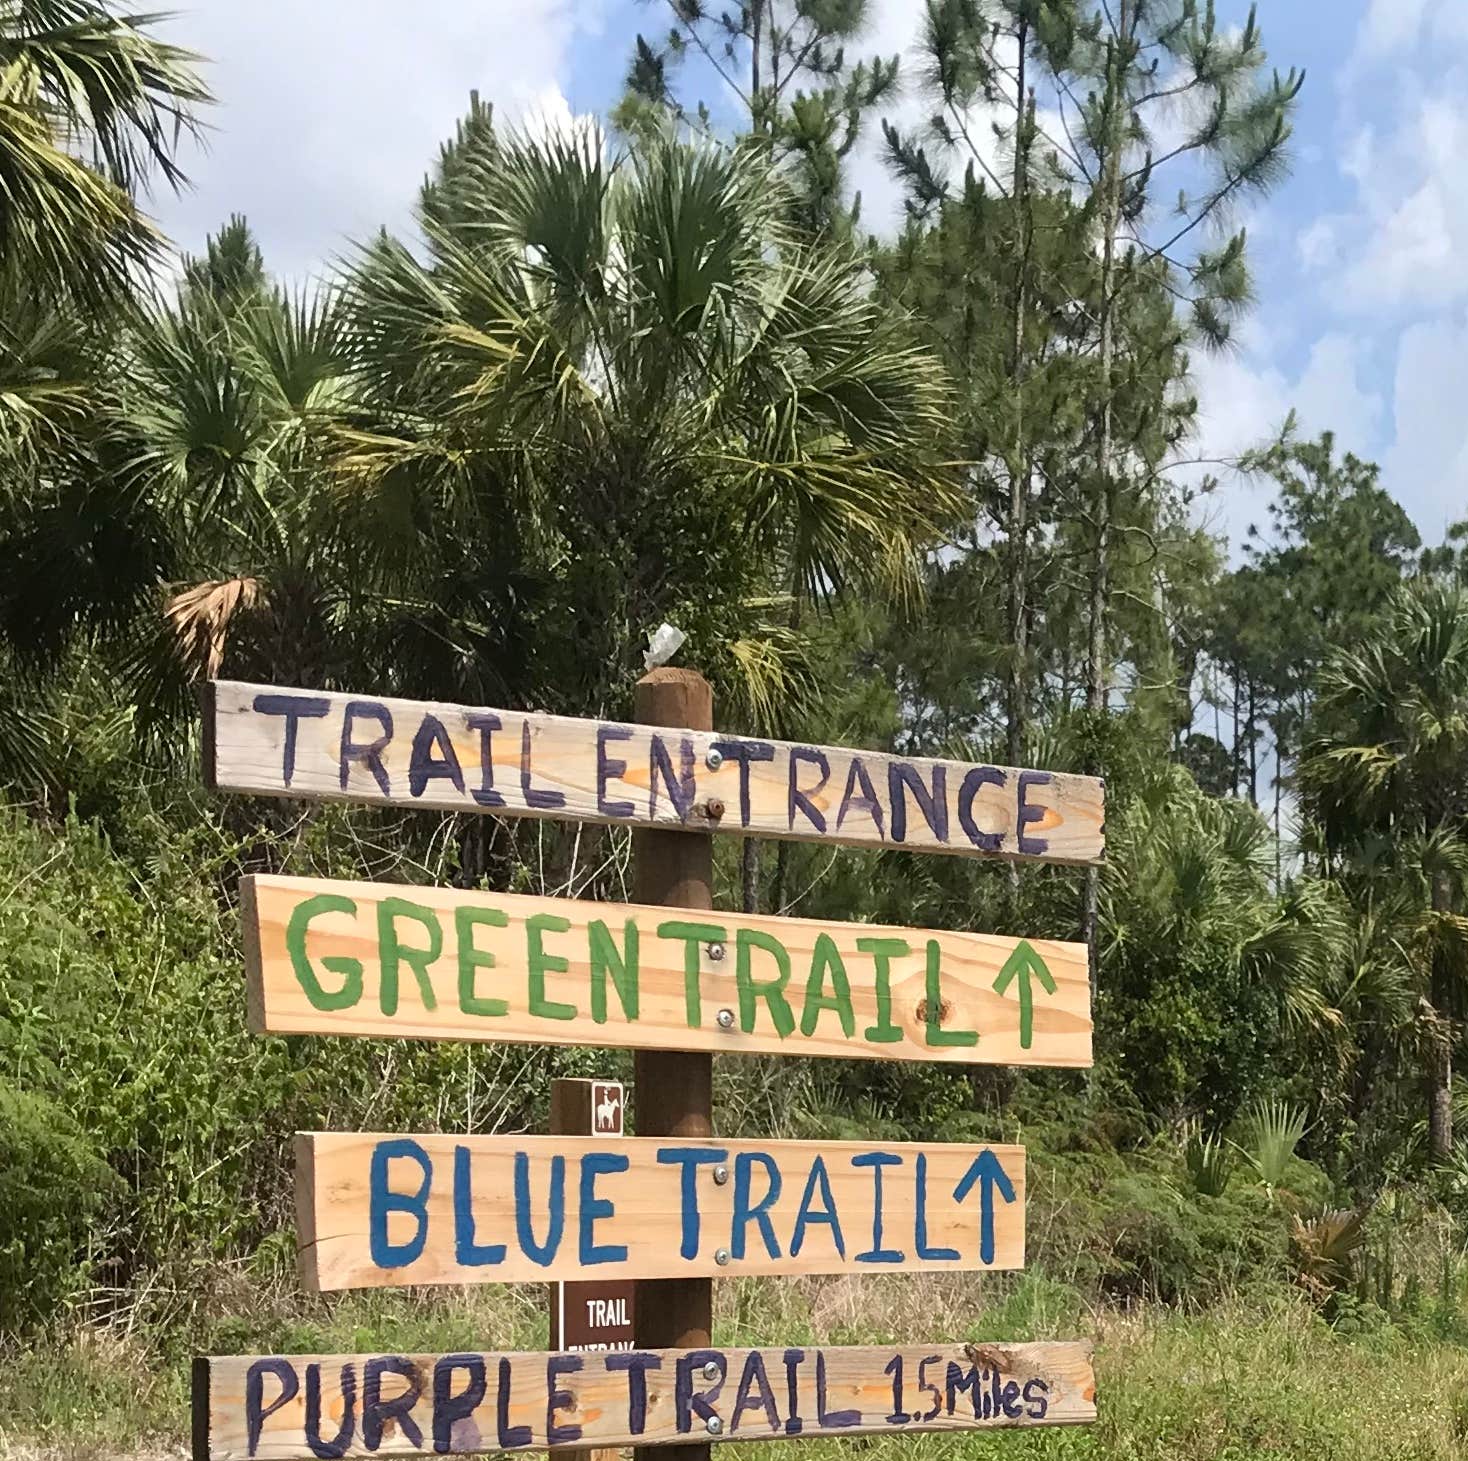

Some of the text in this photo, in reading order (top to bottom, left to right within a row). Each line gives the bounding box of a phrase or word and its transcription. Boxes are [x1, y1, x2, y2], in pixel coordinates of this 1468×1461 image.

[253, 694, 1057, 855] TRAIL ENTRANCE
[286, 893, 980, 1047] GREEN TRAIL
[369, 1138, 962, 1268] BLUE TRAIL
[586, 1298, 631, 1328] TRAIL
[246, 1354, 585, 1459] PURPLE
[605, 1348, 862, 1435] TRAIL
